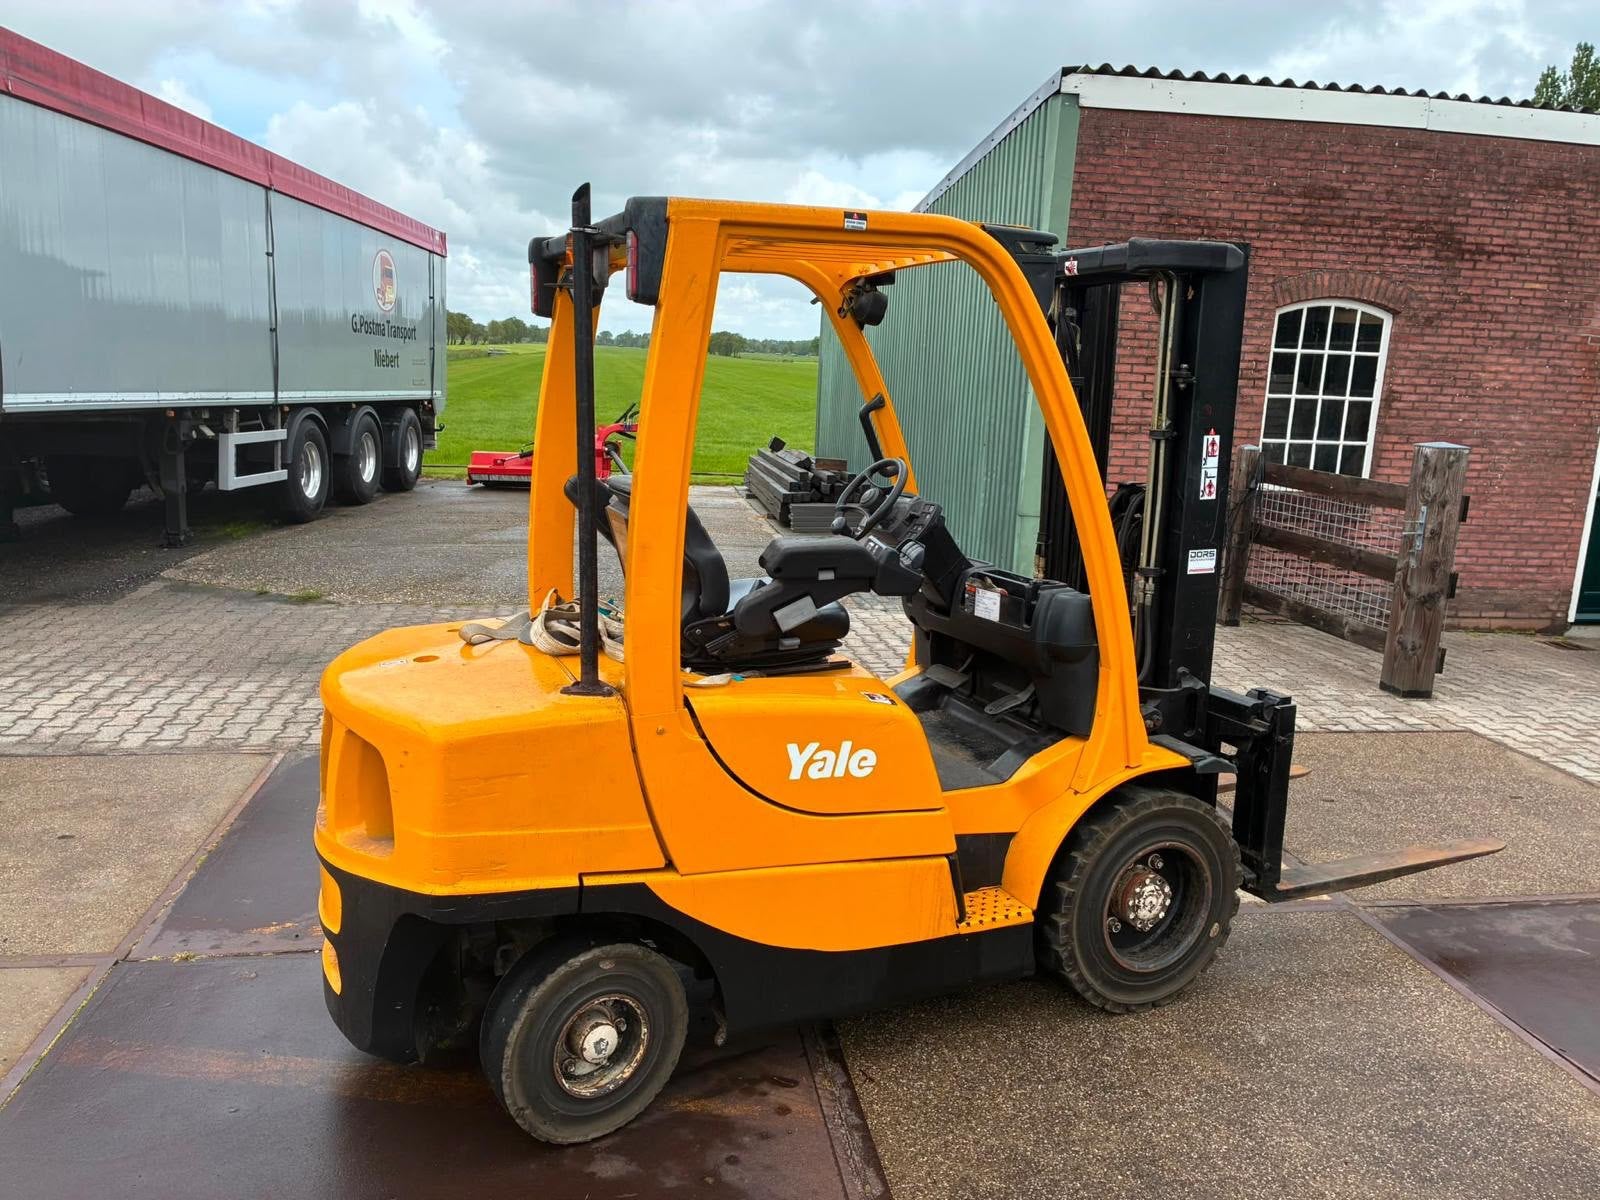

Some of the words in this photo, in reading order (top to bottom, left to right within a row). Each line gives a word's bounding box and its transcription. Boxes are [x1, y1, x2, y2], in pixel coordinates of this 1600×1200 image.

[351, 314, 385, 337] G.Postma
[386, 320, 416, 343] Transport
[374, 349, 400, 368] Niebert
[786, 740, 877, 780] Yale
